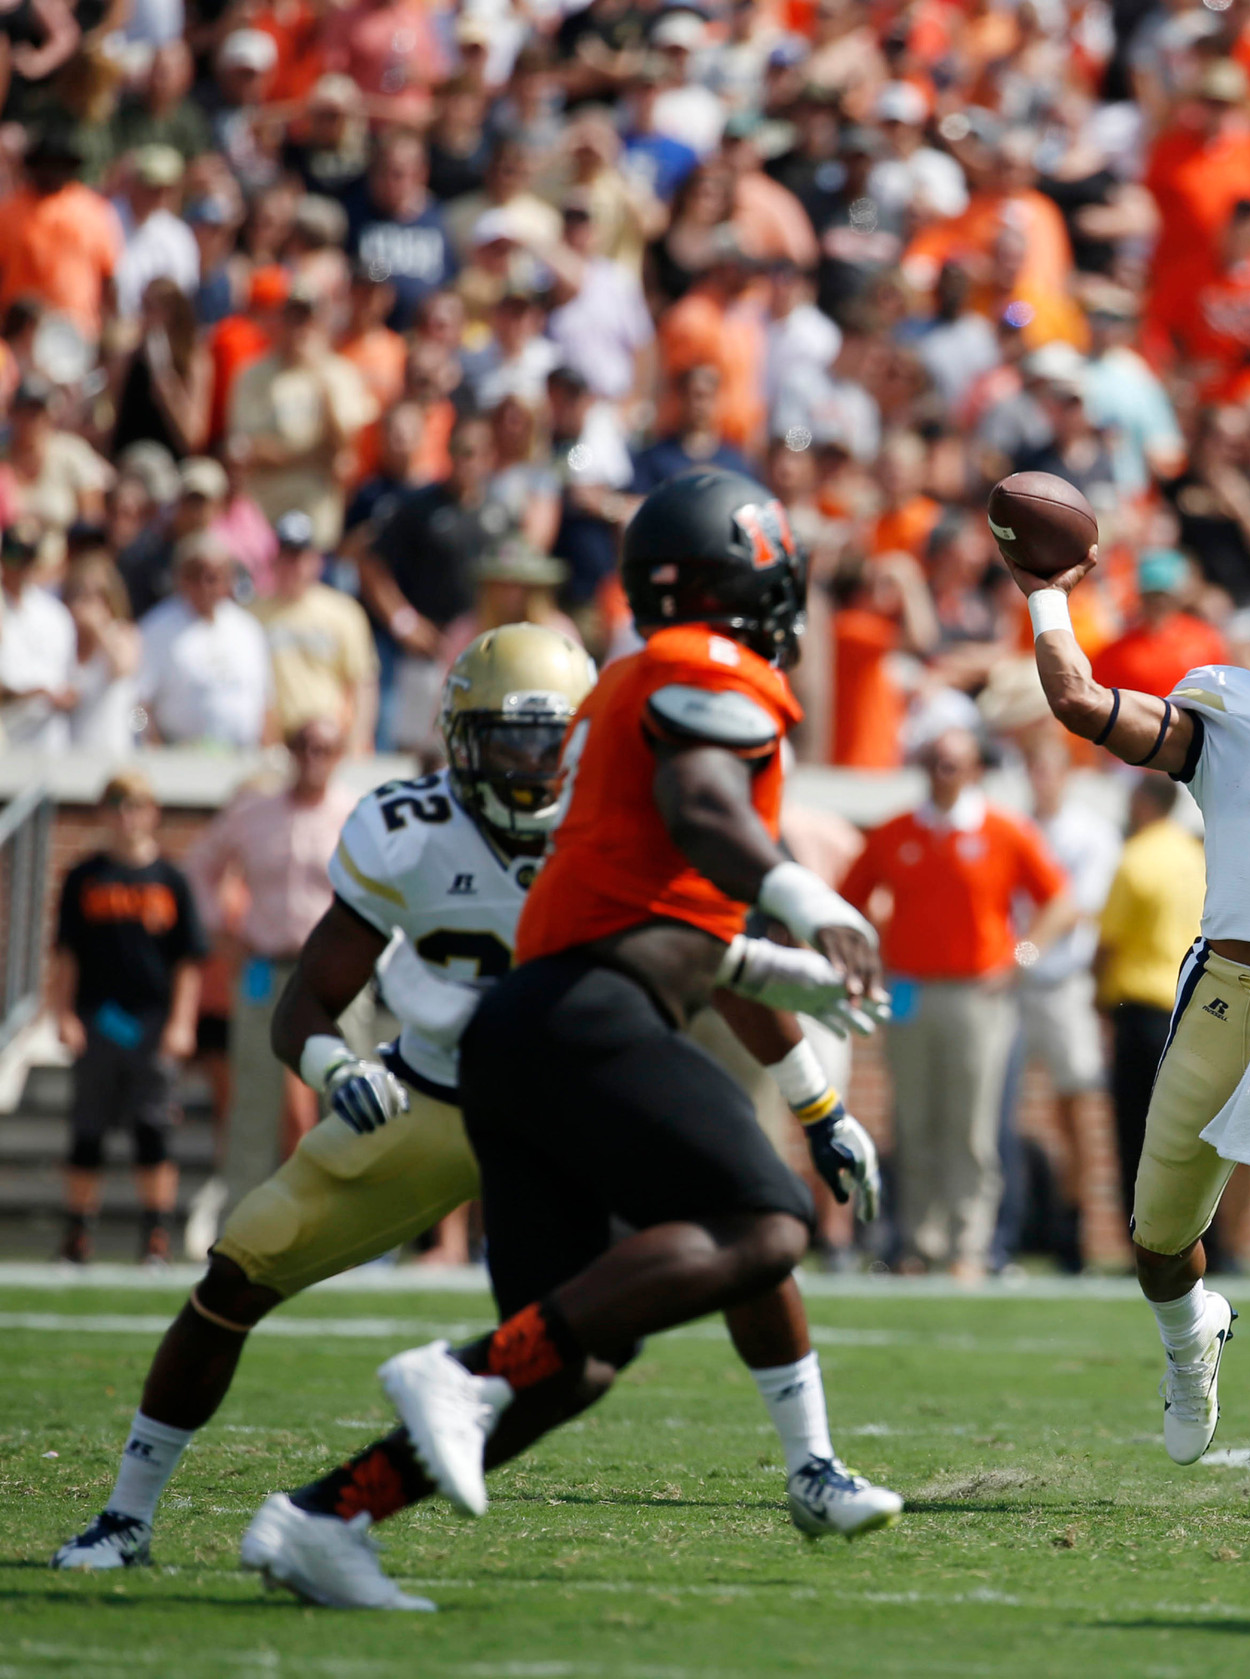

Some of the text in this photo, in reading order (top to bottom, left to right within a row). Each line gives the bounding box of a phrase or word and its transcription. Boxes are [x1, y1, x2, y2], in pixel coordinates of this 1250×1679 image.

[373, 773, 453, 833] 22
[1202, 1005, 1229, 1022] RUSSELL
[1208, 997, 1230, 1015] R
